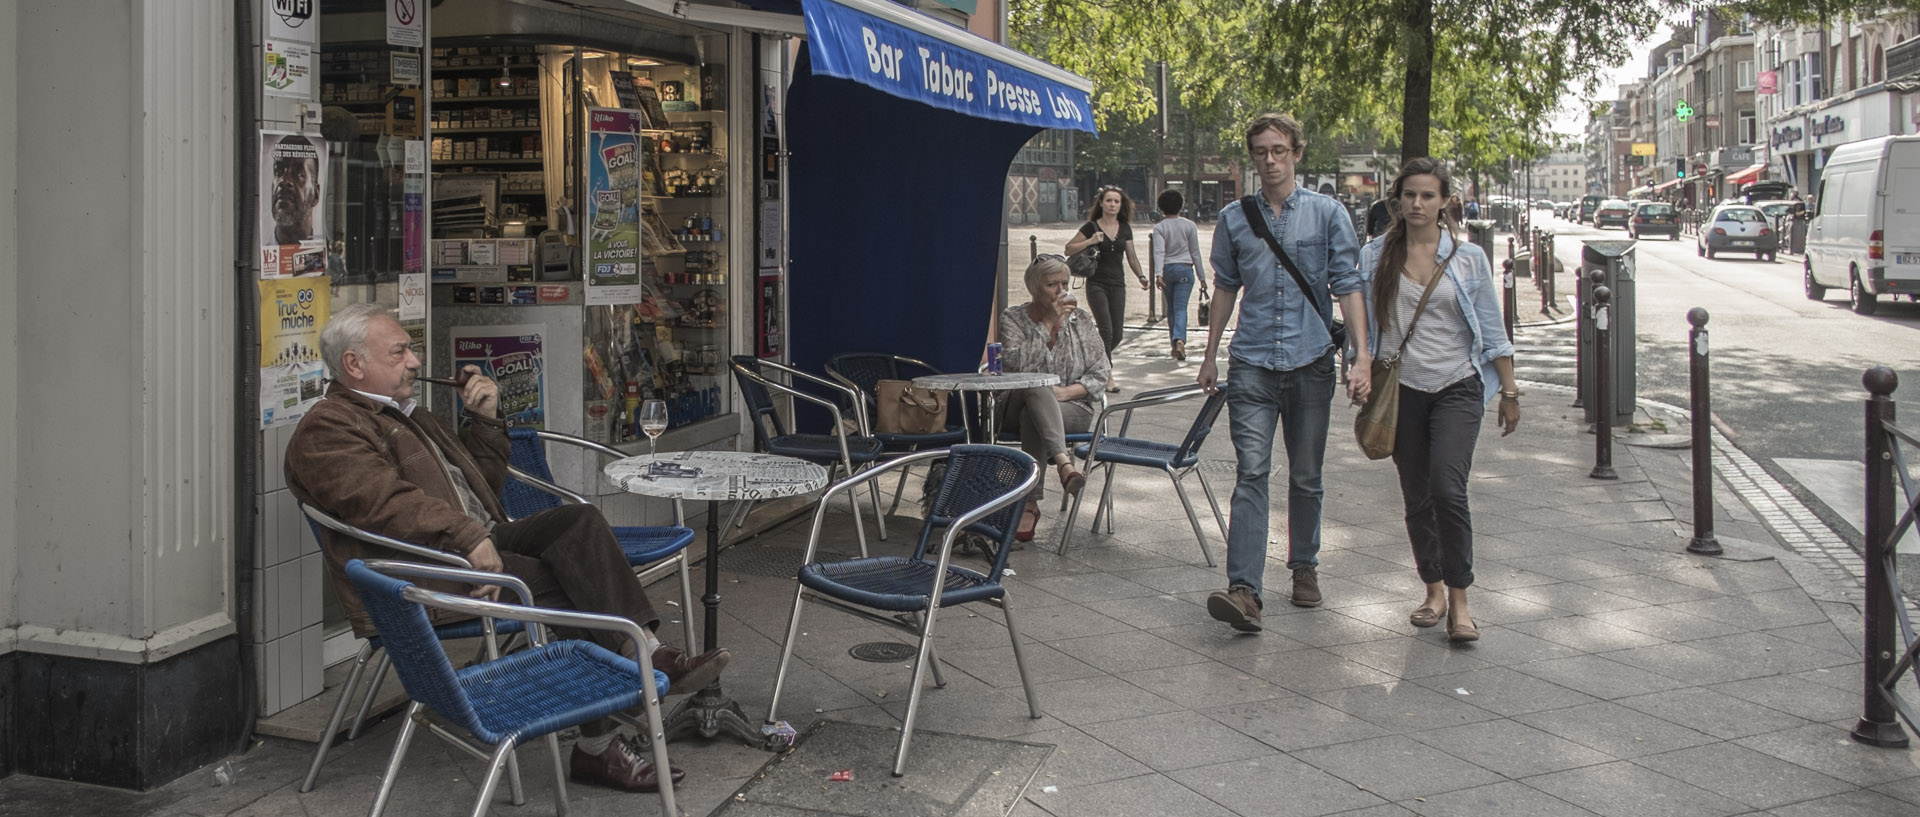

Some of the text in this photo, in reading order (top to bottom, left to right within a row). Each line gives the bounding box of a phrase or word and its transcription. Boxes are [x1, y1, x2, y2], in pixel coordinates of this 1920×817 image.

[862, 26, 1083, 123] Bar Tabac Presse Loto
[608, 151, 636, 169] GOAL!
[613, 239, 628, 249] VOUS
[593, 251, 602, 259] LA
[597, 265, 611, 273] FDJ
[405, 287, 425, 297] NICKEL
[276, 299, 298, 317] Truc
[281, 312, 314, 330] muche
[496, 359, 533, 377] GOAL!
